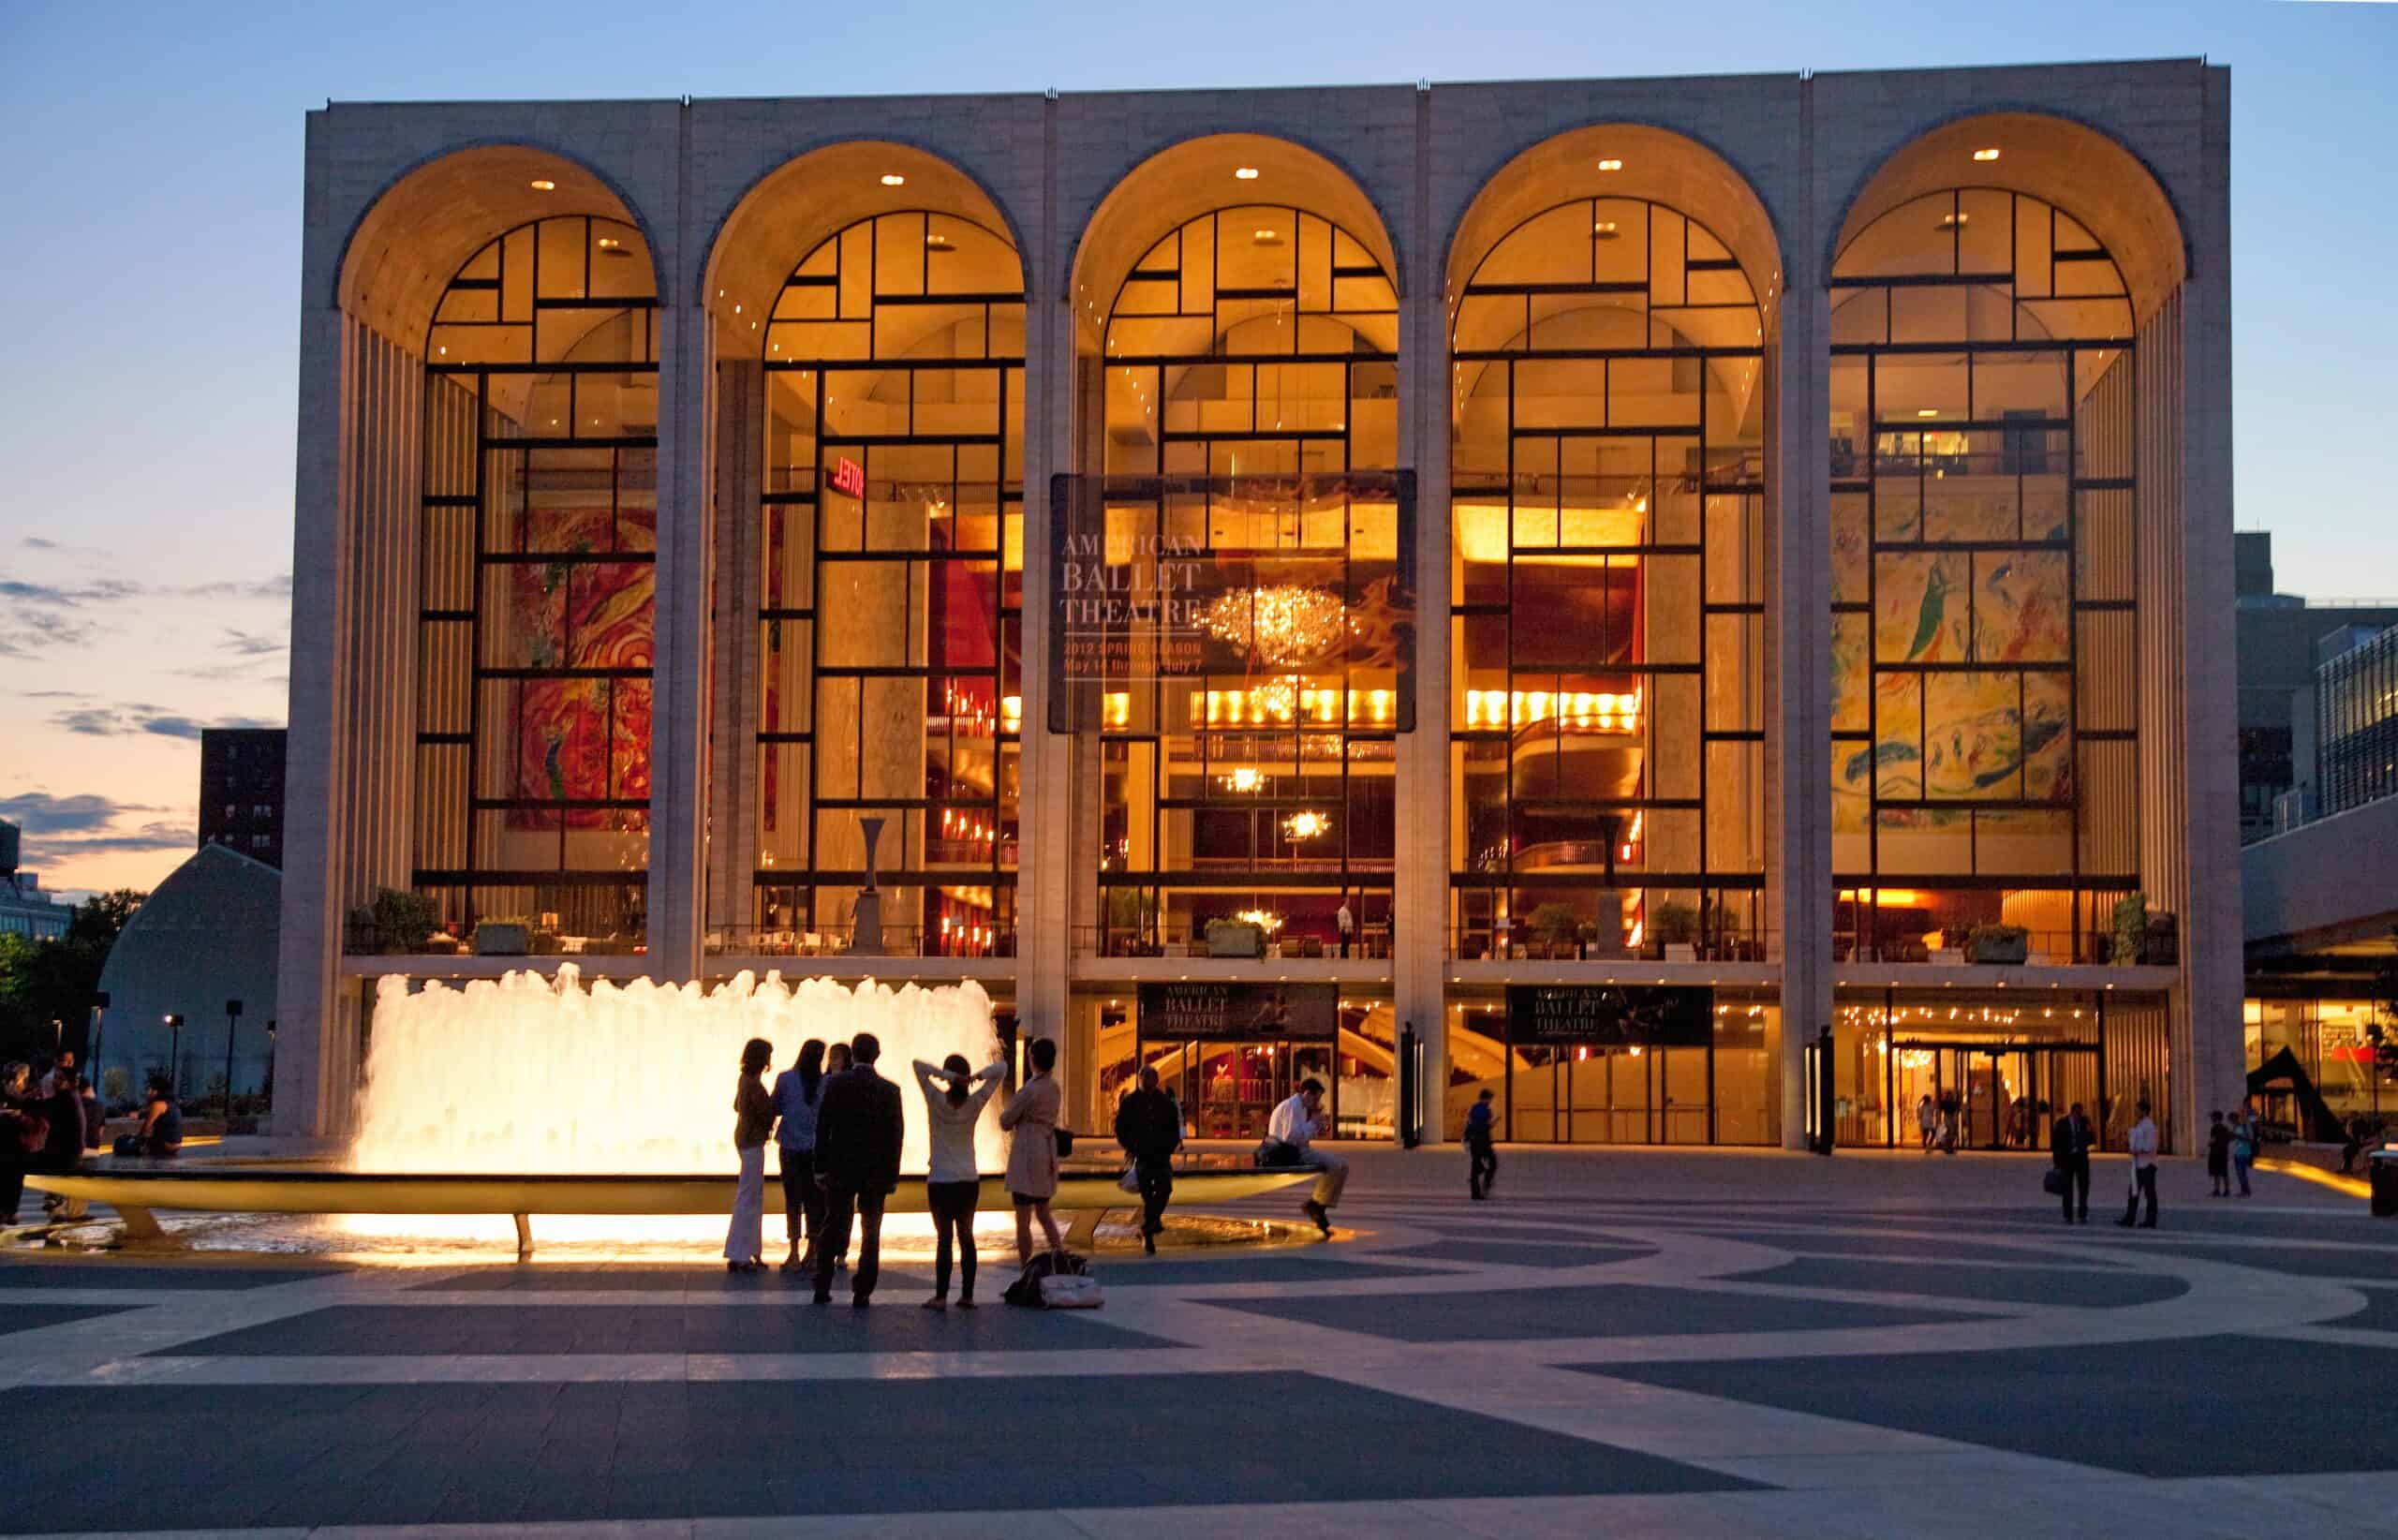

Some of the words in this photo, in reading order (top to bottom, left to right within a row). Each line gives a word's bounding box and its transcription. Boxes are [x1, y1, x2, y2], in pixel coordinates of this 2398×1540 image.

[1062, 535, 1201, 555] AMERICAN
[1061, 563, 1201, 592] BALLET
[1059, 599, 1201, 623] THEATRE
[1064, 643, 1094, 655] 2012
[1064, 659, 1088, 674] May
[1167, 985, 1228, 996] AMERICAN
[1165, 997, 1228, 1013] BALLET
[1535, 1000, 1599, 1015] BALLET
[1163, 1014, 1224, 1028] THEATRE
[1536, 1017, 1595, 1030] THEATRE
